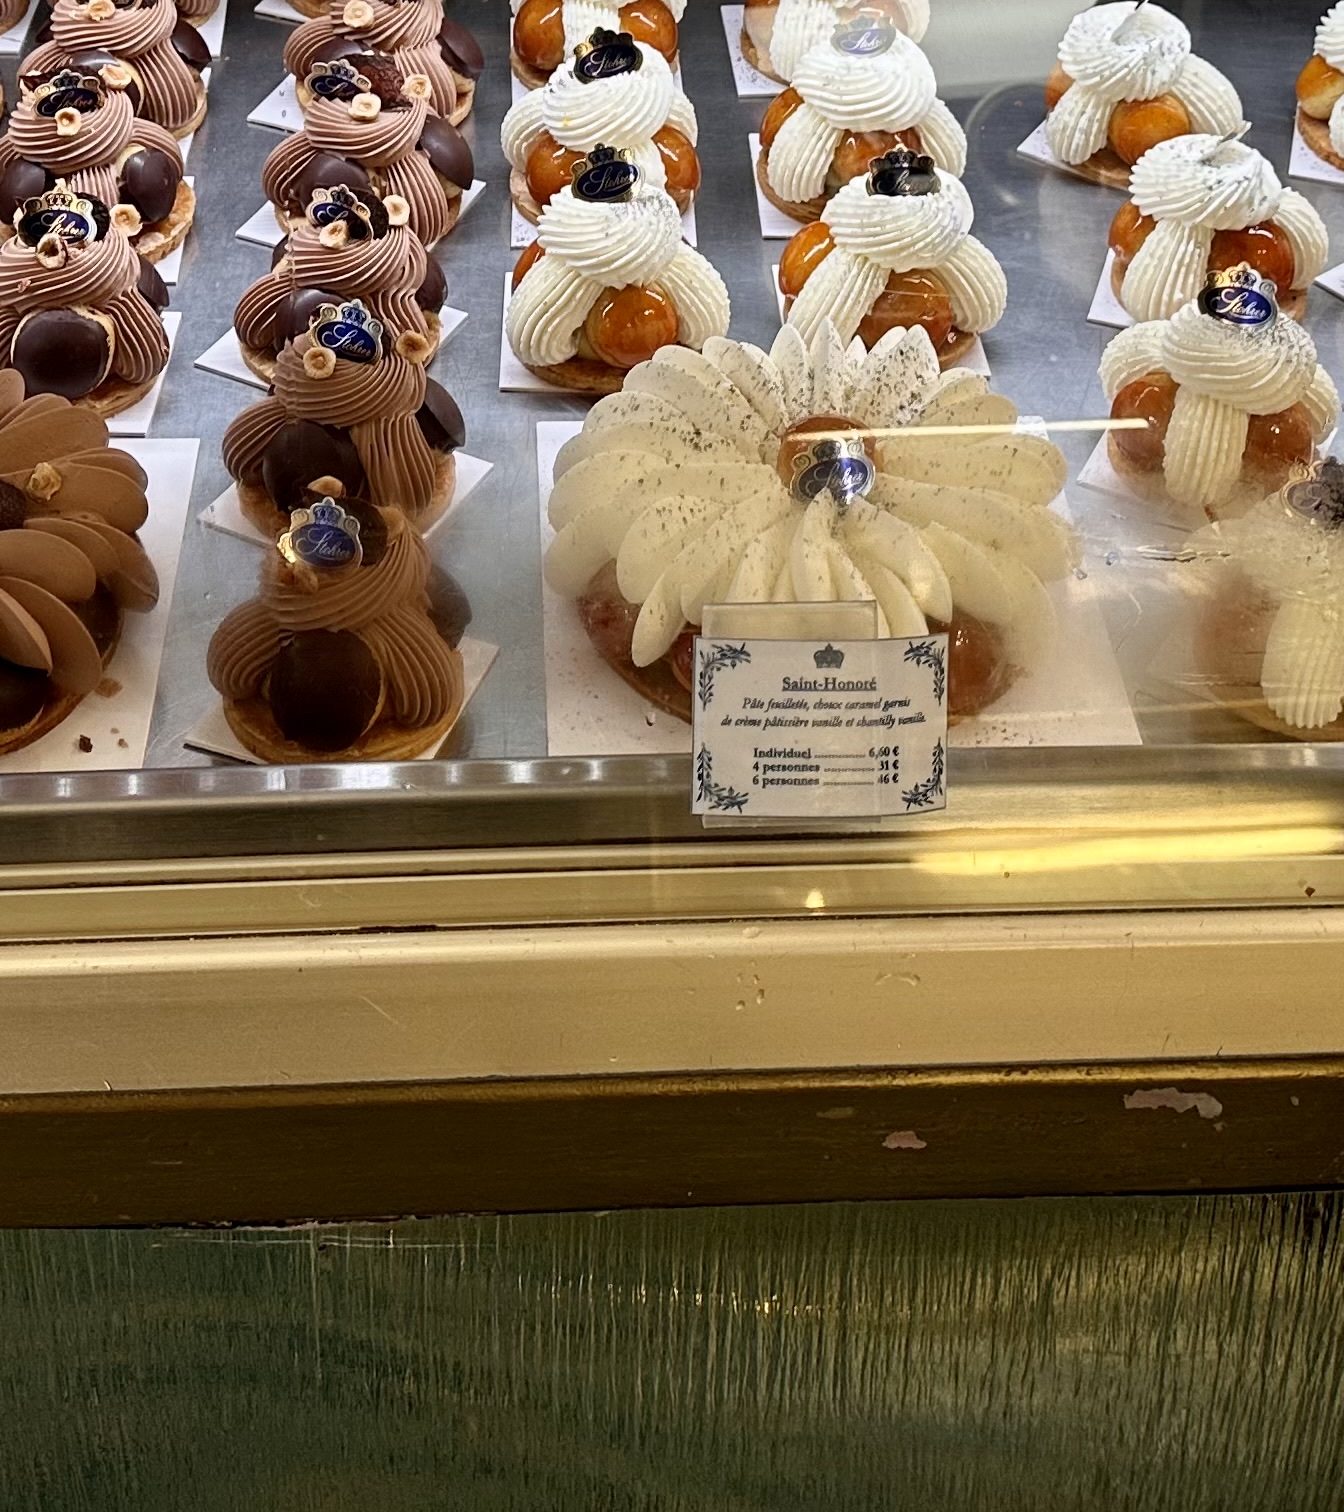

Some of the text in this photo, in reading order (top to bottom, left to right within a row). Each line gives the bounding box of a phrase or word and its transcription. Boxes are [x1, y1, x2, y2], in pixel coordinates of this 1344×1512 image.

[782, 676, 877, 691] Saint-Honoré
[742, 697, 764, 709] Pâte
[720, 715, 732, 726] de
[753, 748, 812, 759] Individuel
[892, 746, 899, 756] €
[752, 761, 759, 772] 4
[762, 763, 820, 775] personnes
[892, 759, 899, 770] €
[752, 775, 759, 785] 6
[762, 777, 820, 788] personnes
[892, 773, 899, 783] €
